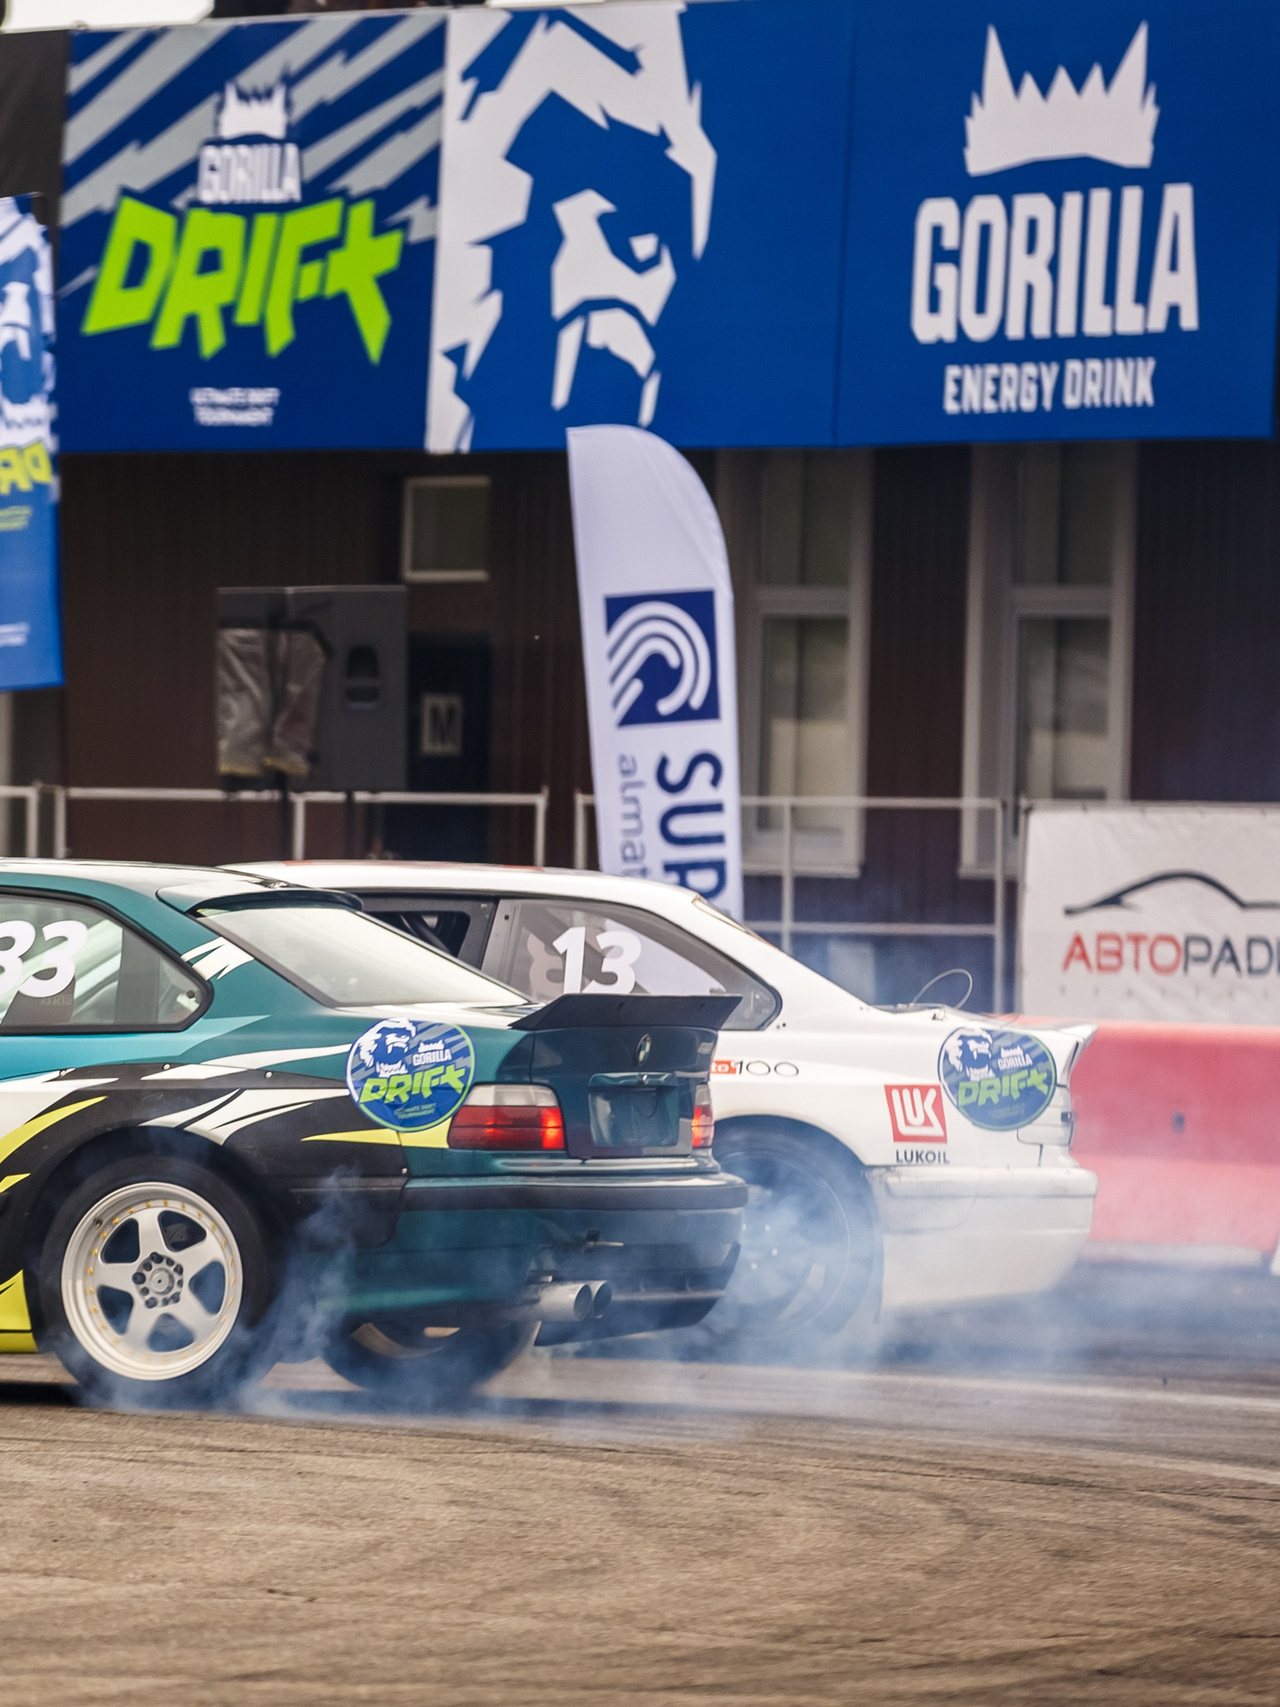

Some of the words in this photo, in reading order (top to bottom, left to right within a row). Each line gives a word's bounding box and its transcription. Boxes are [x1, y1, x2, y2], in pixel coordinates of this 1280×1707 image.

[199, 142, 302, 204] GORILLA
[910, 183, 1199, 344] GORILLA
[943, 361, 1059, 415] ENERGY
[1063, 357, 1157, 409] DRINK
[617, 753, 653, 880] almat
[552, 926, 642, 995] 13
[412, 1048, 453, 1067] GORILLA
[734, 1060, 800, 1077] 100
[997, 1053, 1034, 1071] GORILLA
[358, 1064, 467, 1105] DRIFT
[895, 1149, 951, 1164] LUKOIL
